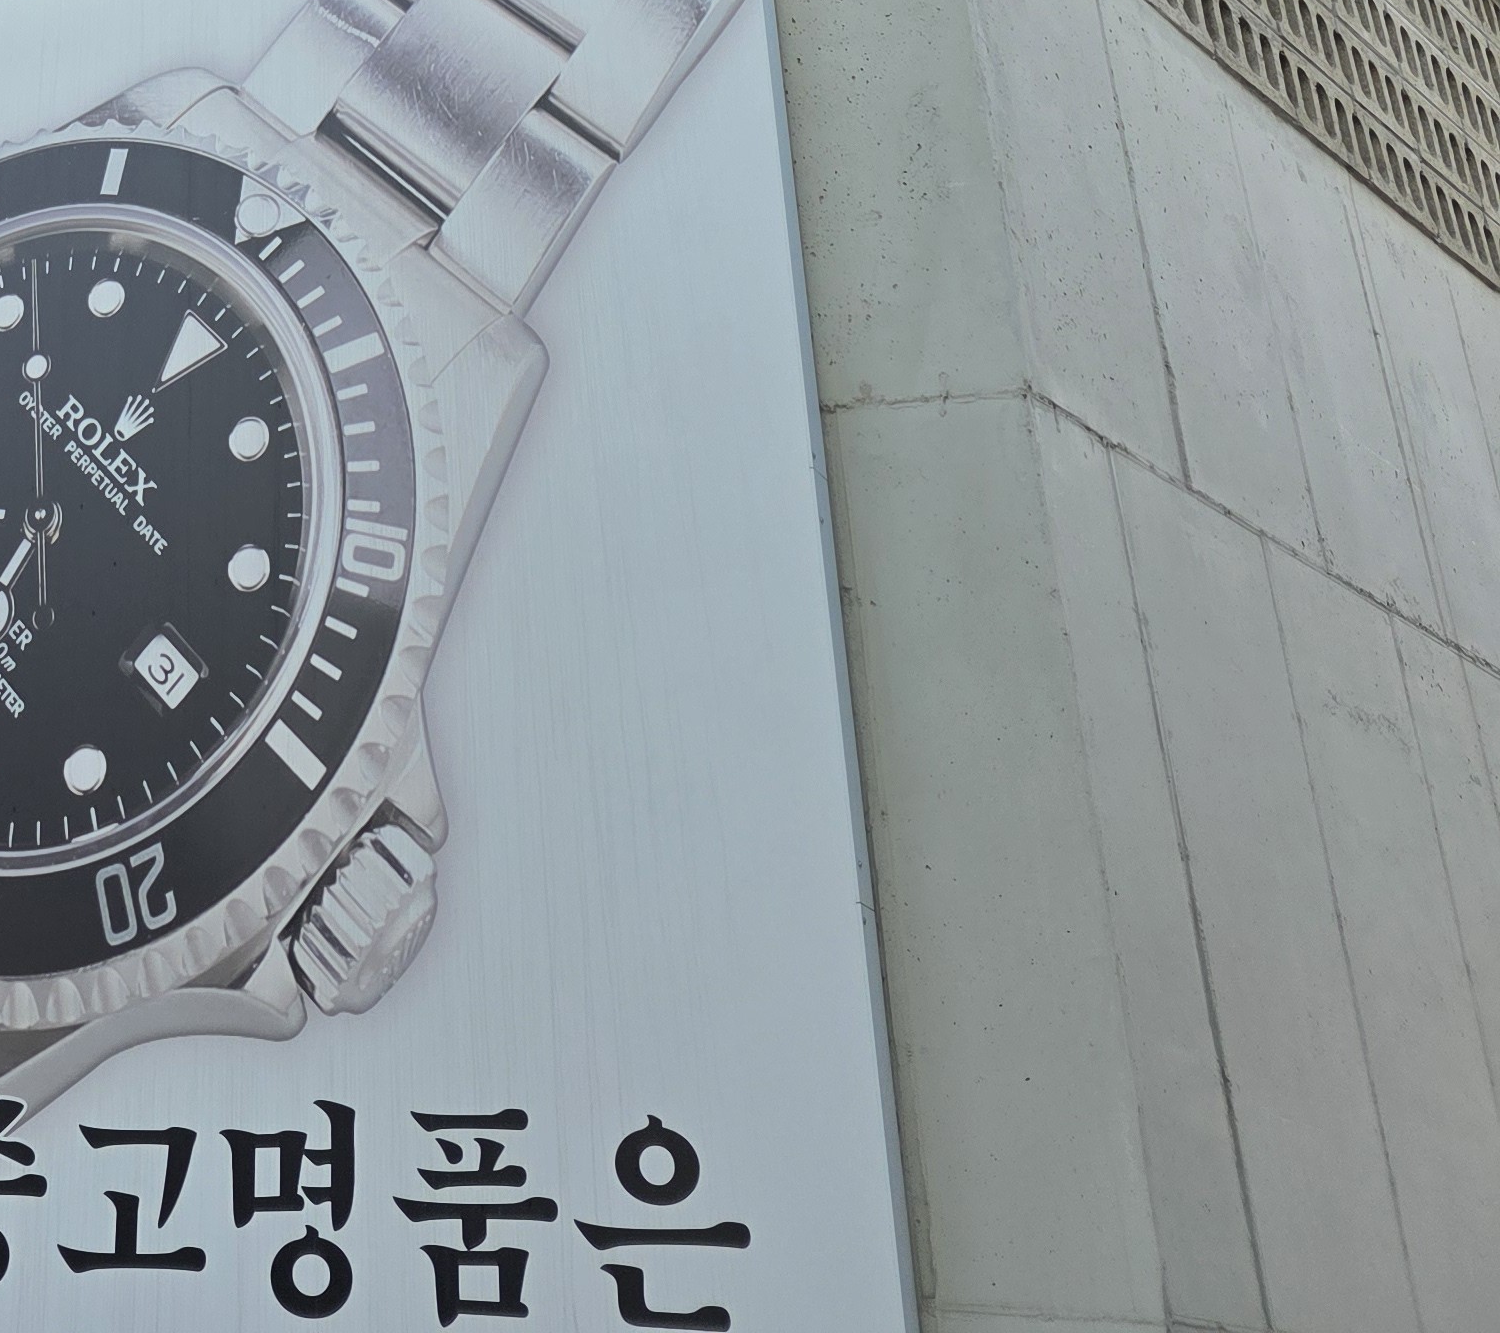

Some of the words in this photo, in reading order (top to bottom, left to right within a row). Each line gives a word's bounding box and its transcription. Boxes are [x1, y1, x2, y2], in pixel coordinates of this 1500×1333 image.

[56, 394, 158, 507] ROLEX
[64, 440, 131, 516] PERPETUAL
[132, 515, 168, 556] DATE
[341, 516, 408, 582] 10
[147, 653, 185, 696] 31
[95, 841, 177, 946] 20
